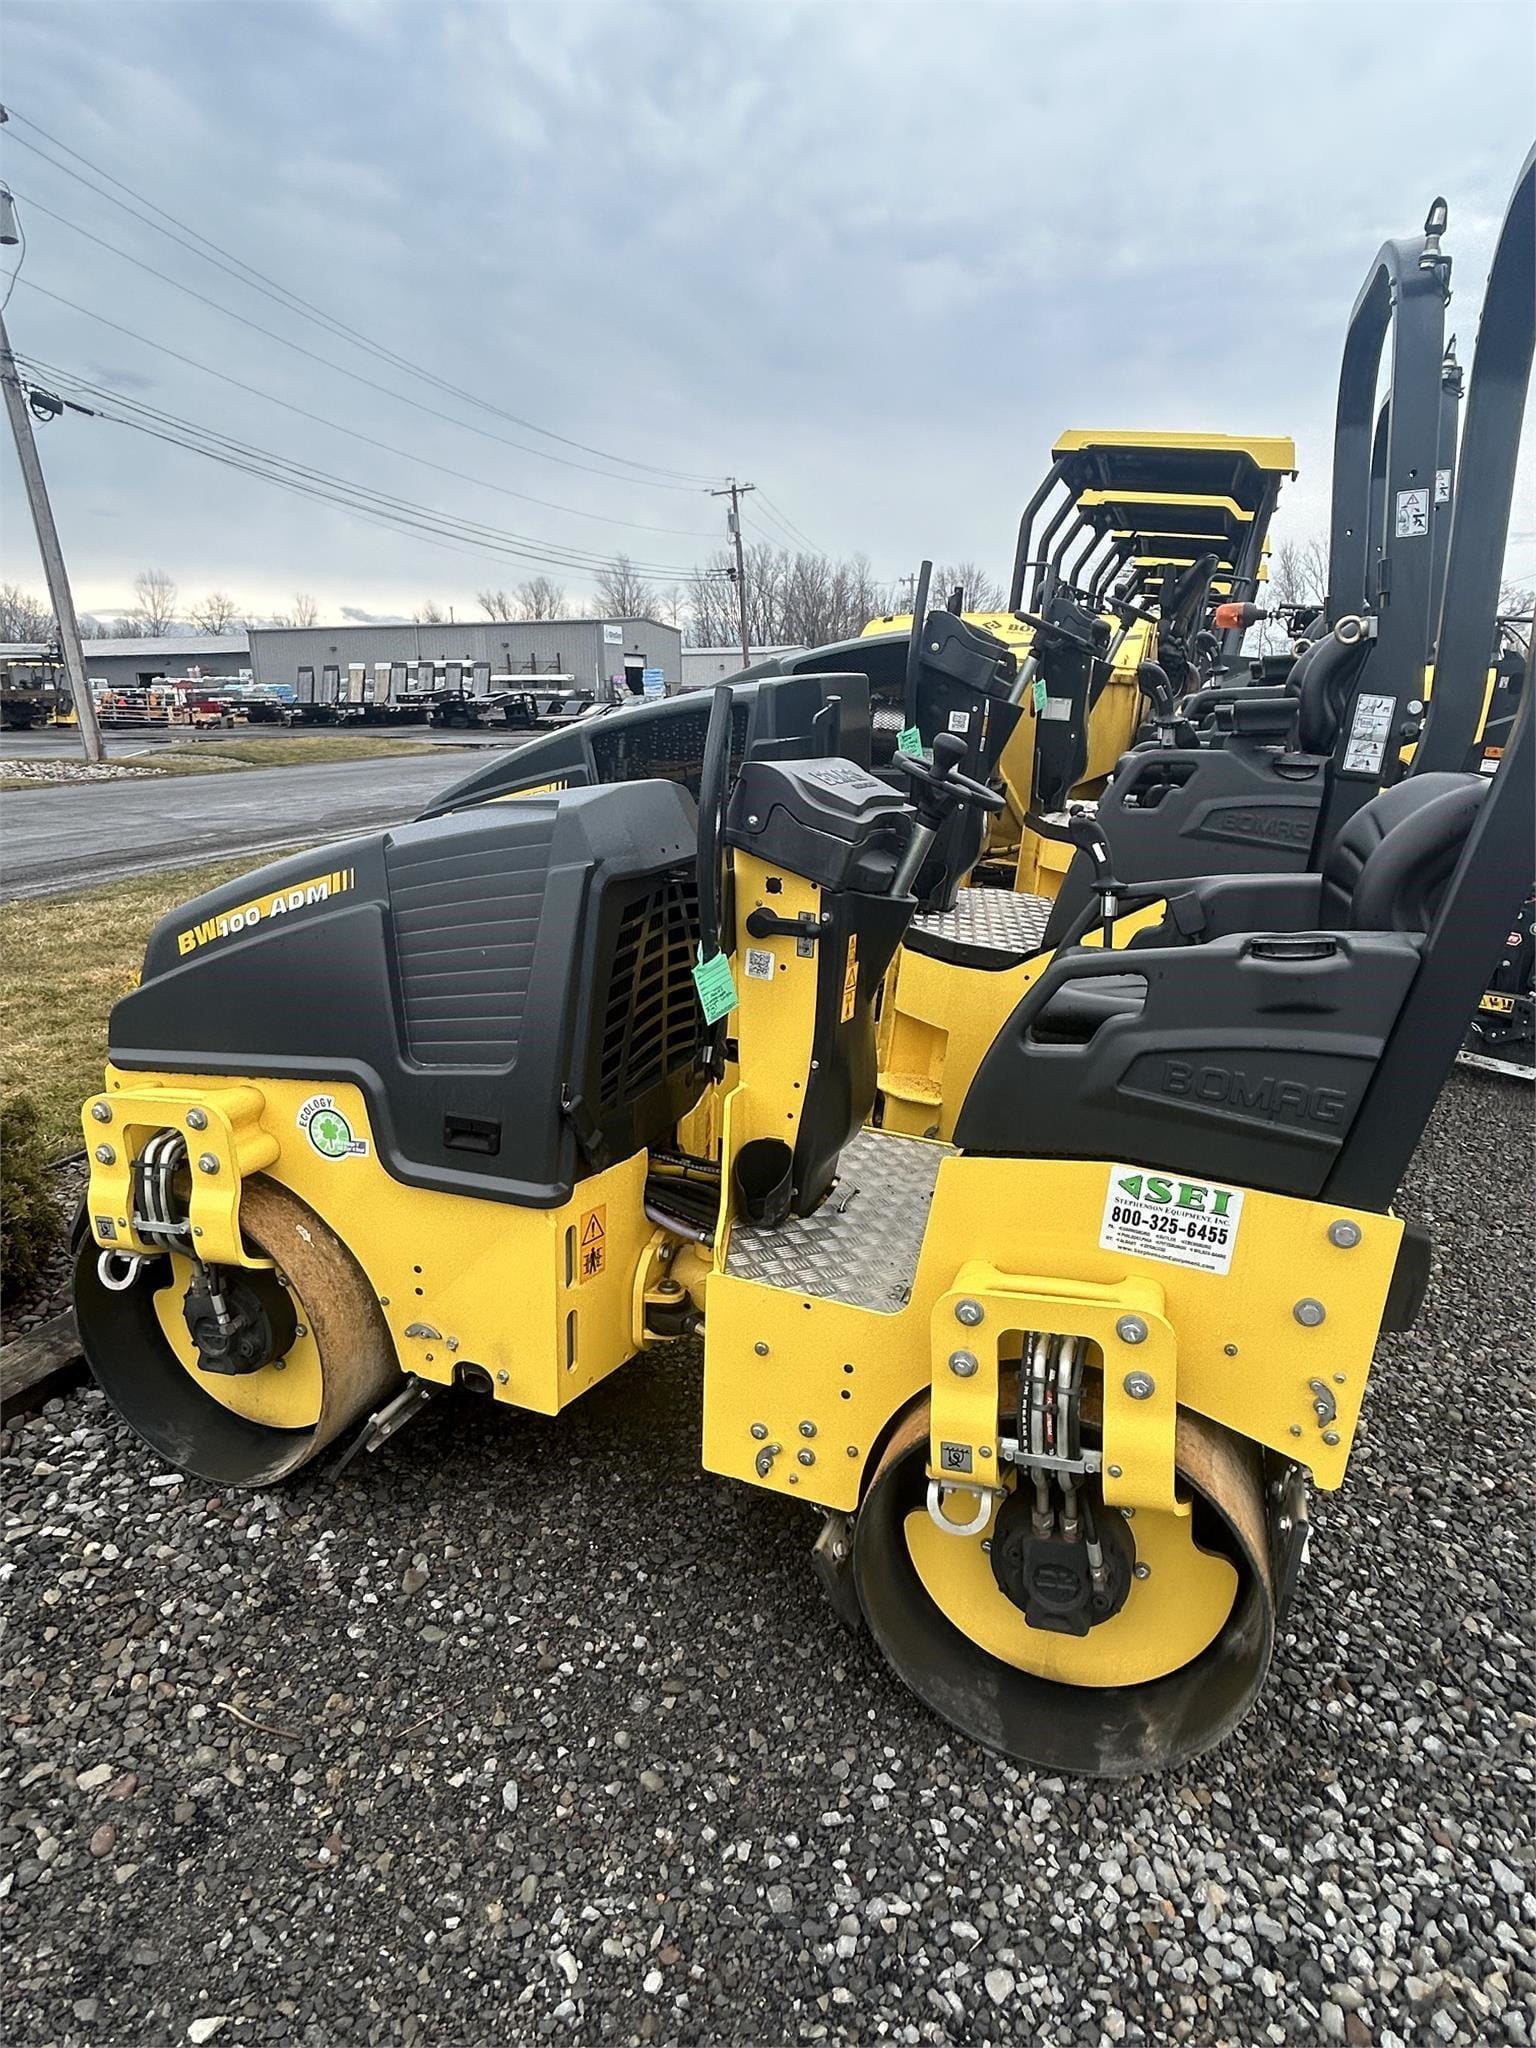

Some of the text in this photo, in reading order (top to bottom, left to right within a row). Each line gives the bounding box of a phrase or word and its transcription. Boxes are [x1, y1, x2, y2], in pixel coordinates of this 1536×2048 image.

[269, 882, 329, 919] ADM
[1162, 1060, 1347, 1125] BOMAG
[299, 1098, 332, 1127] ECOLOGY
[1144, 1177, 1234, 1218] SEI
[1111, 1206, 1229, 1245] 800-325-6455
